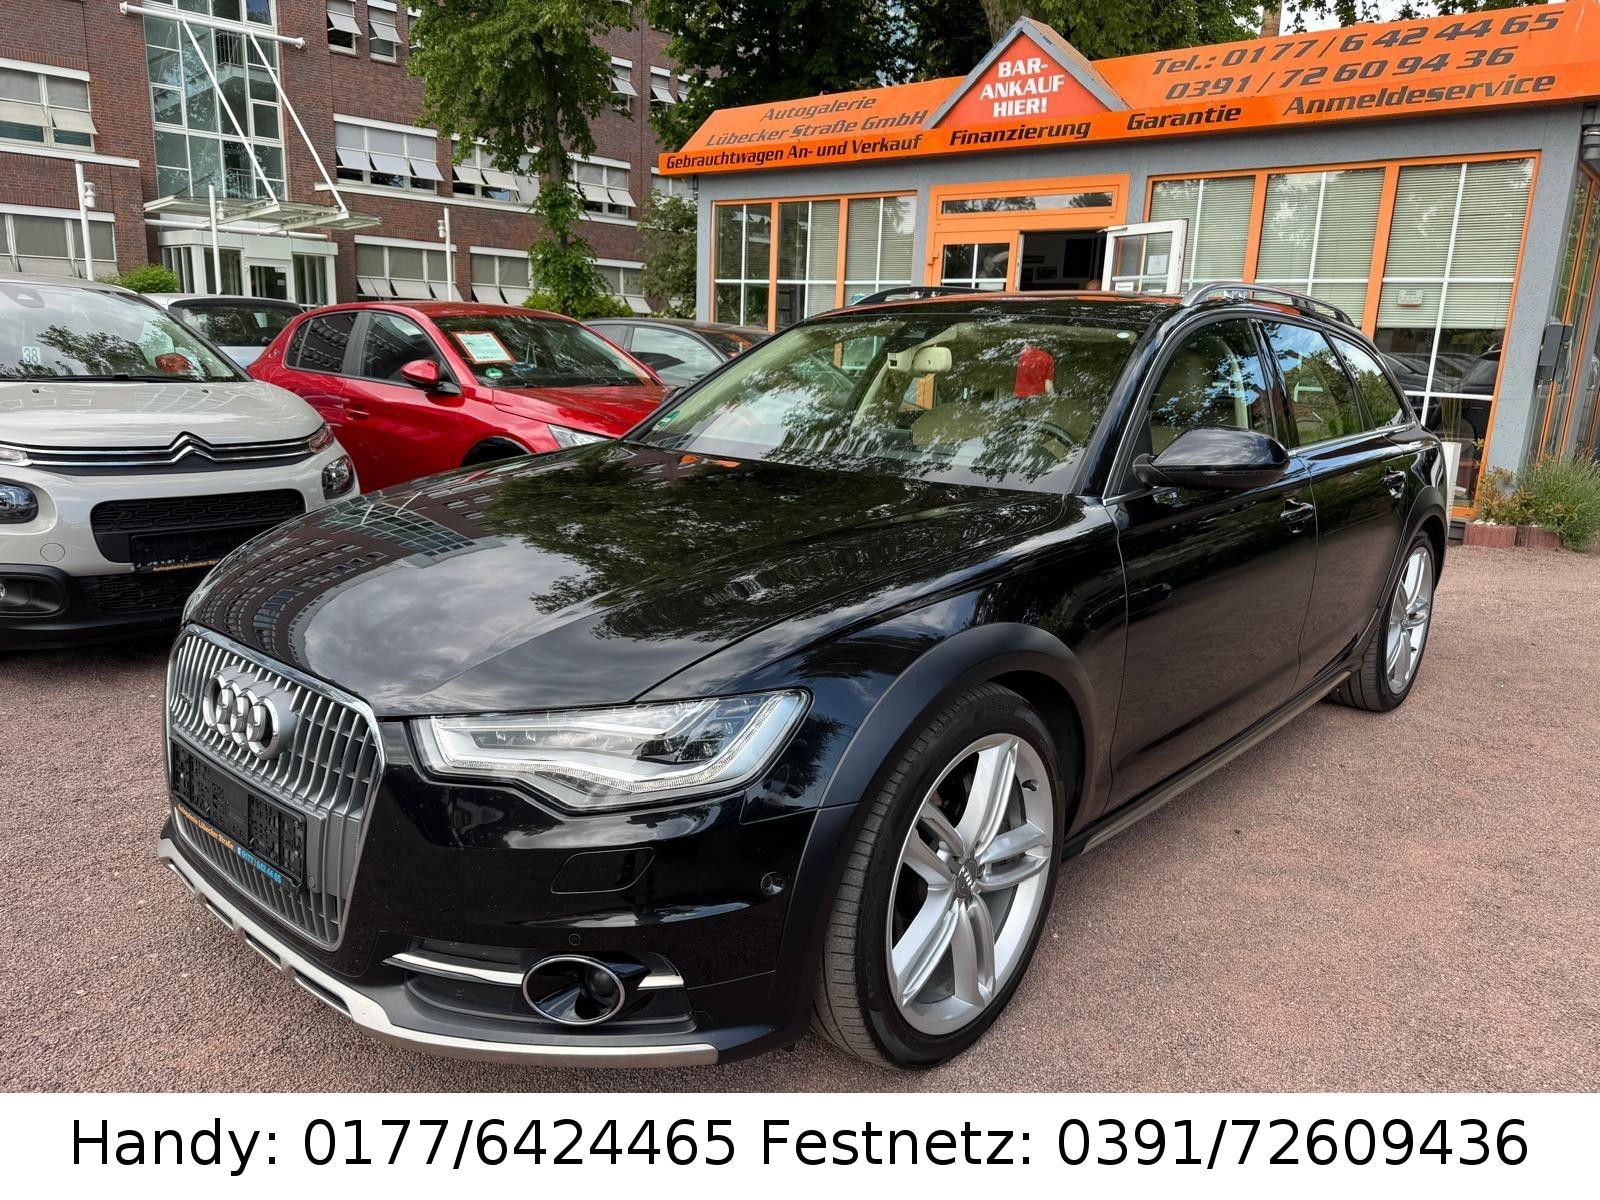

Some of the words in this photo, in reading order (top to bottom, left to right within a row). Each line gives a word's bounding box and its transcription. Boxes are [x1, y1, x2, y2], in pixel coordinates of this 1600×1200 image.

[1153, 54, 1216, 75] Tel.:
[1221, 39, 1319, 67] 0177
[1372, 26, 1429, 48] 42
[1433, 18, 1494, 42] 44
[1499, 10, 1565, 36] 65
[997, 56, 1049, 78] BAR-
[1164, 74, 1253, 100] 0391
[1278, 66, 1329, 89] 72
[1332, 59, 1389, 83] 60
[1391, 53, 1451, 76] 94
[1455, 45, 1519, 70] 36
[979, 74, 1065, 101] ANKAUF
[1282, 73, 1556, 116] Anmeldeservice
[760, 95, 877, 122] Autogalerie
[992, 97, 1048, 118] HIER!
[1126, 103, 1242, 131] Garantie
[705, 127, 791, 147] Lübecker
[788, 118, 858, 139] Straße
[860, 109, 929, 131] GmbH
[948, 119, 1091, 146] Finanzierung
[666, 148, 784, 169] Gebrauchtwagen
[786, 144, 813, 159] An-
[816, 139, 848, 157] und
[851, 133, 924, 155] Verkauf
